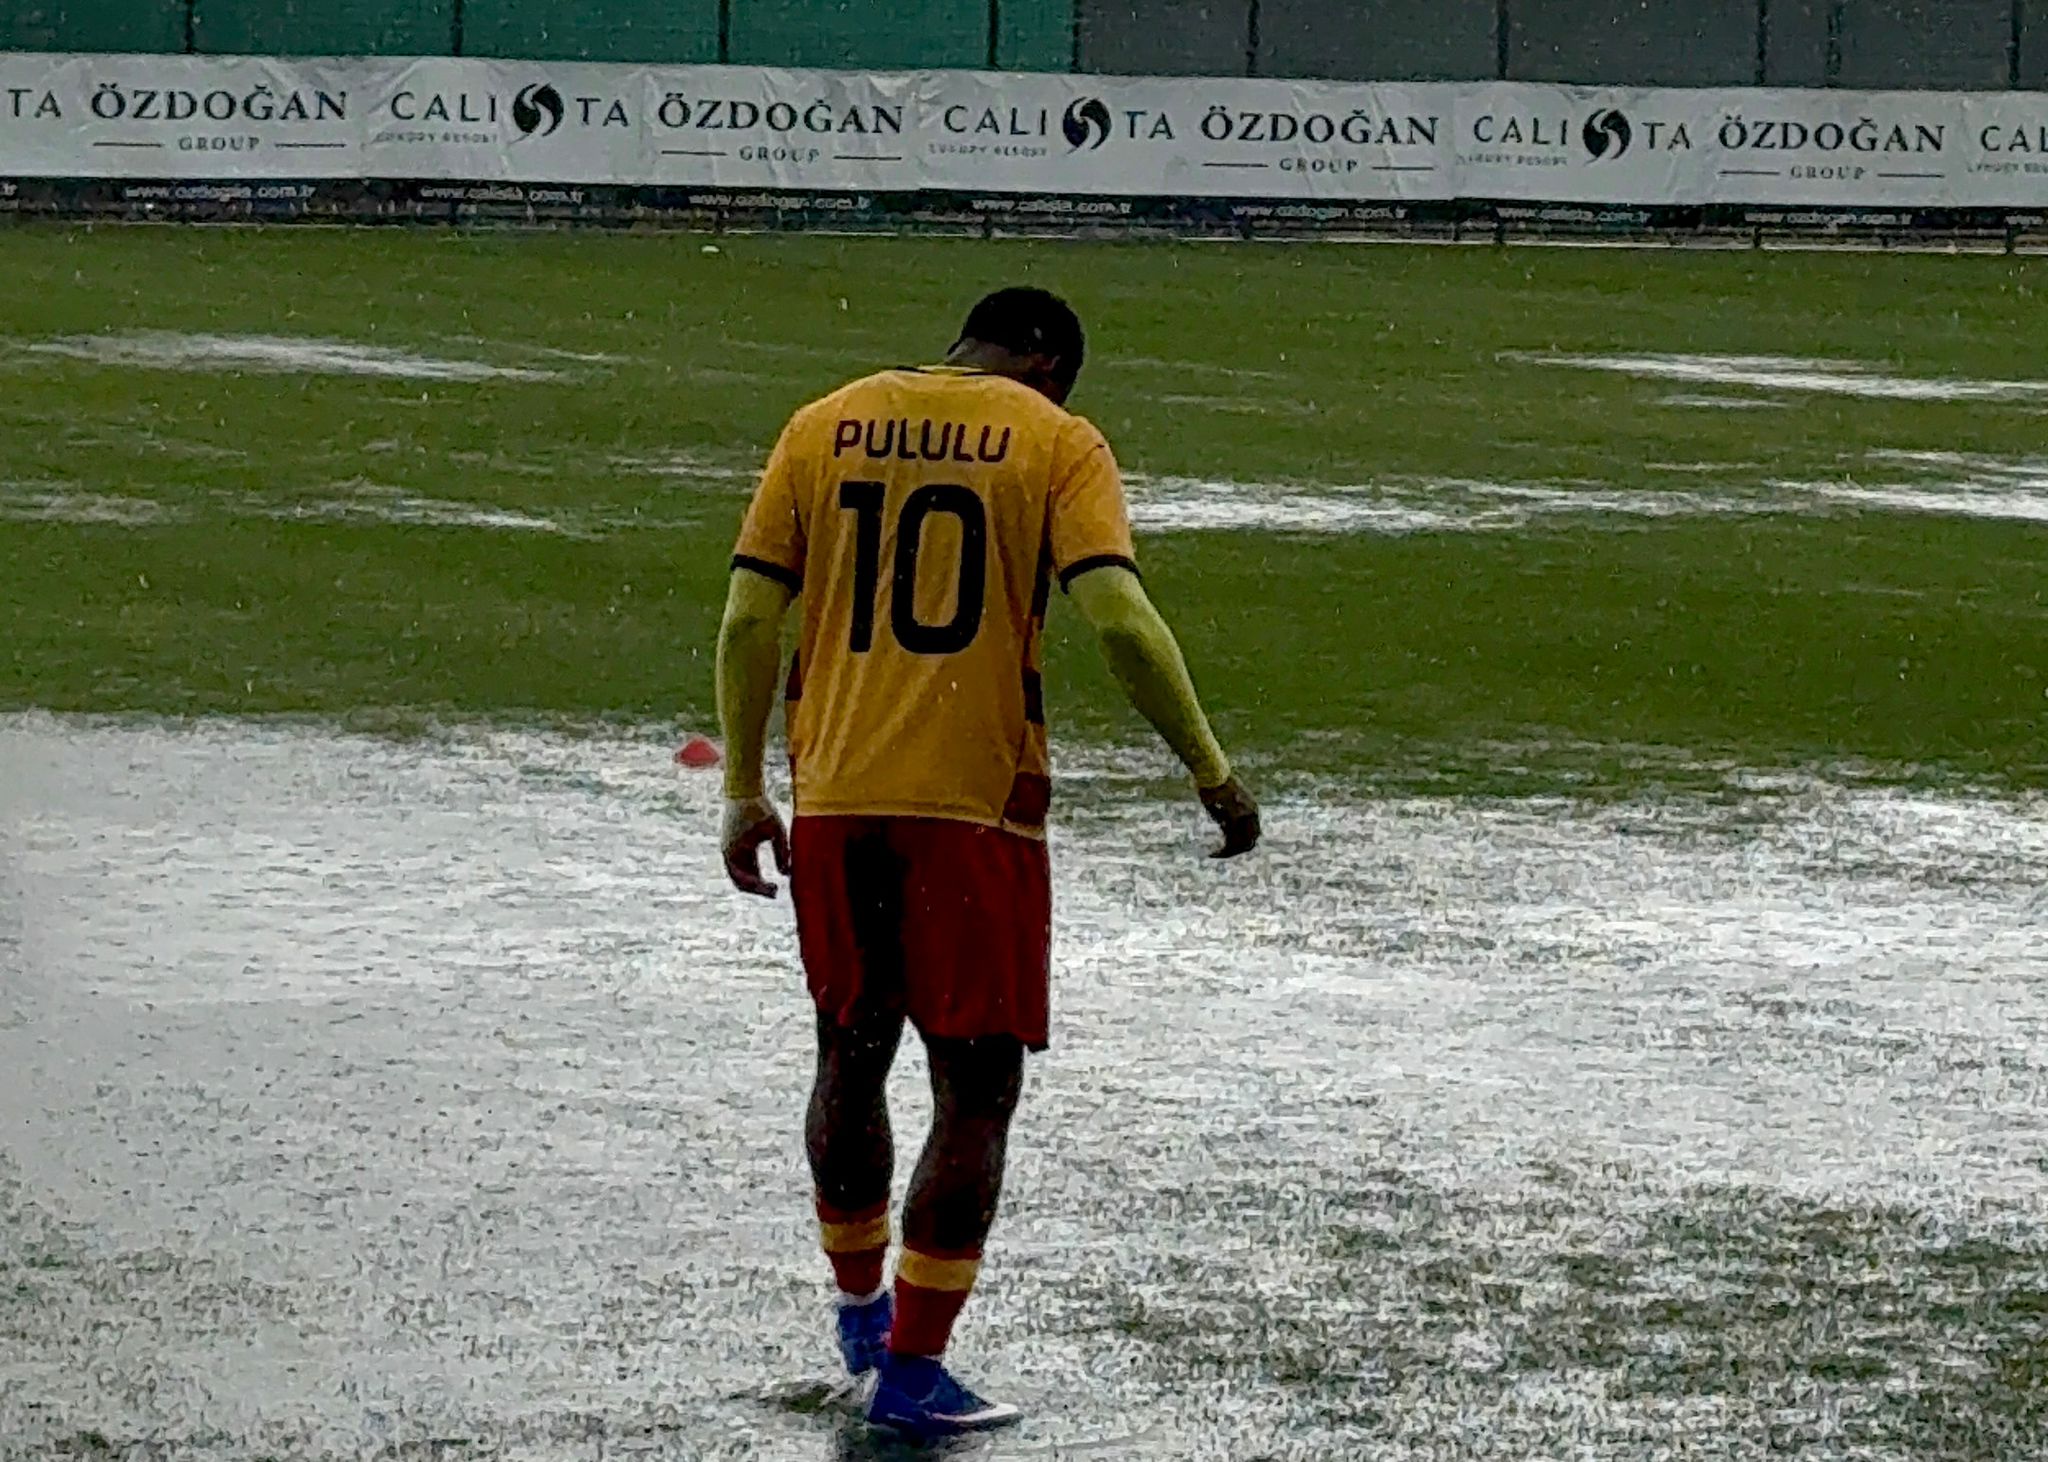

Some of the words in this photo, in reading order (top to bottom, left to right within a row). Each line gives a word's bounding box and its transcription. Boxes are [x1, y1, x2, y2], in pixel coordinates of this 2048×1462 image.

[91, 82, 347, 121] ÖZDOĞAN
[657, 92, 903, 134] ÖZDOĞAN
[178, 135, 260, 152] GROUP
[1200, 105, 1439, 146] ÖZDOĞAN
[1718, 114, 1945, 153] ÖZDOĞAN
[739, 145, 820, 164] GROUP
[1279, 157, 1358, 174] GROUP
[1790, 165, 1866, 180] GROUP
[833, 418, 1011, 463] PULULU
[839, 480, 987, 655] 10
